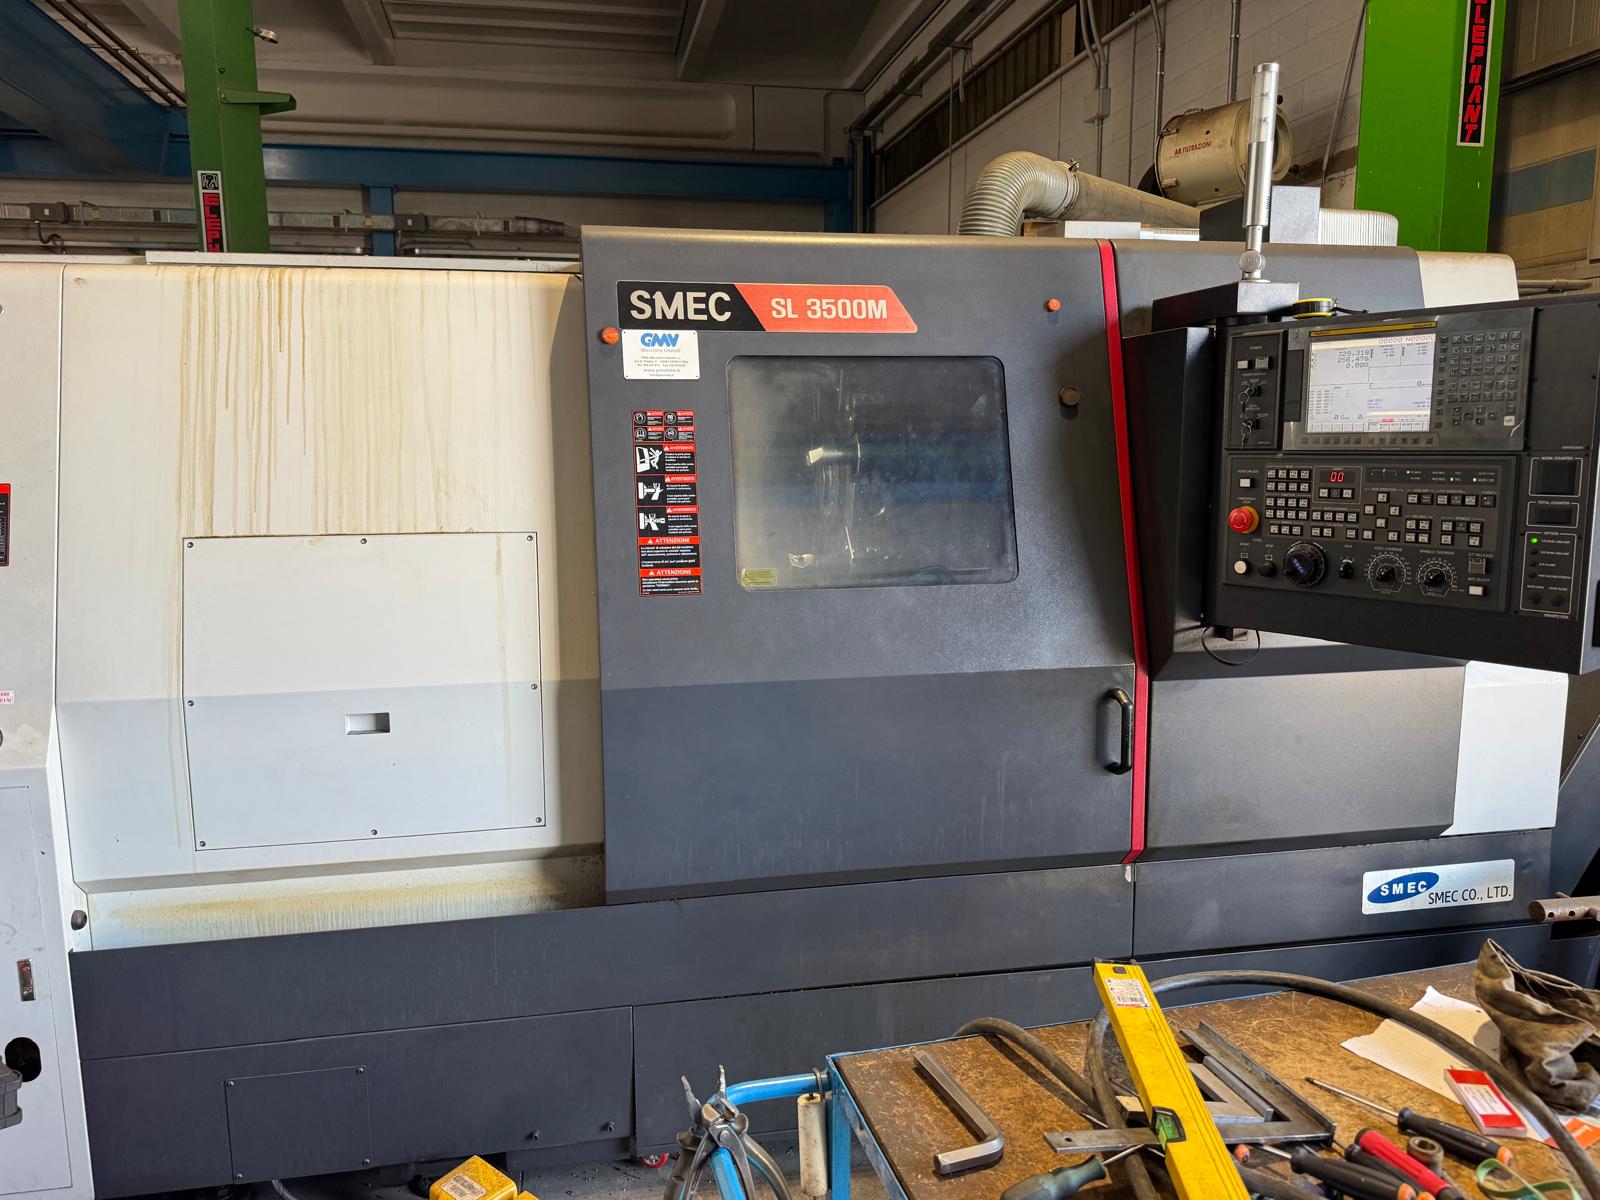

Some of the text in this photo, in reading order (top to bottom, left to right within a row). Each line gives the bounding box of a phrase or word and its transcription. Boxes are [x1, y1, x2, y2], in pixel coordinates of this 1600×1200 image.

[1464, 0, 1487, 142] LEPHANT
[630, 290, 732, 322] SMEC
[771, 298, 888, 320] SL 3500M
[640, 332, 680, 348] GMV
[1330, 472, 1345, 482] 00
[1380, 880, 1427, 896] SMEC
[1428, 886, 1511, 905] SMEC CO., LTD.
